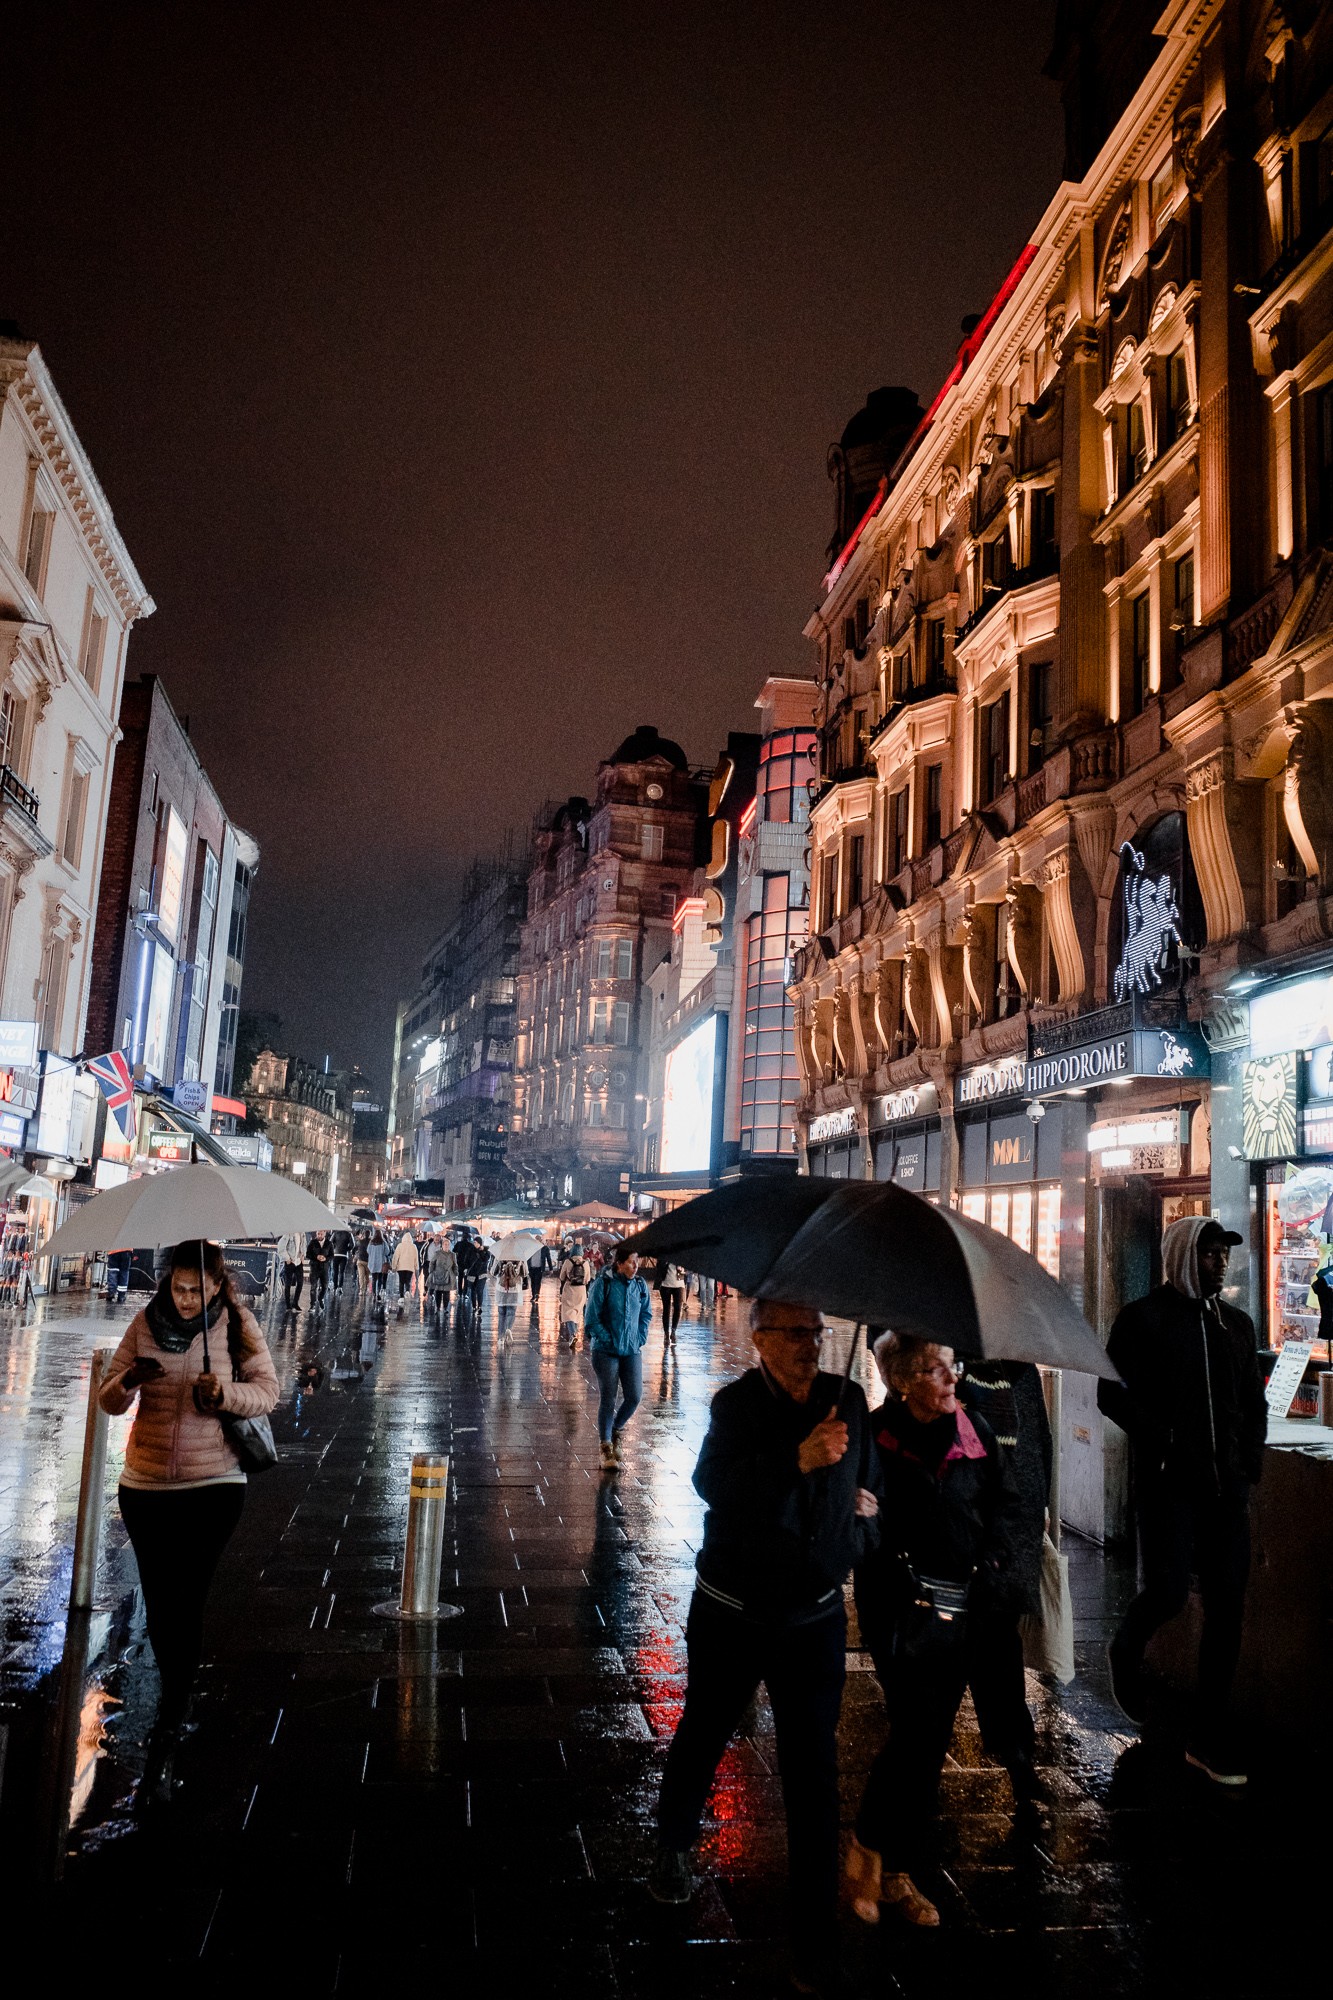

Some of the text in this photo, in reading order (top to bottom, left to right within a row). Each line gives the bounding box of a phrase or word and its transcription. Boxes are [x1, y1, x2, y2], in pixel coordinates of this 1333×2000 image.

[1028, 1042, 1127, 1092] HIPPODROME
[184, 1093, 200, 1101] Chips
[884, 1095, 919, 1120] CASINO
[809, 1112, 855, 1140] HIPPODROME
[151, 1135, 189, 1149] COFFEE BAR
[226, 1138, 249, 1146] GENIUS
[160, 1147, 178, 1158] OPEN
[905, 1153, 919, 1164] OFFICE
